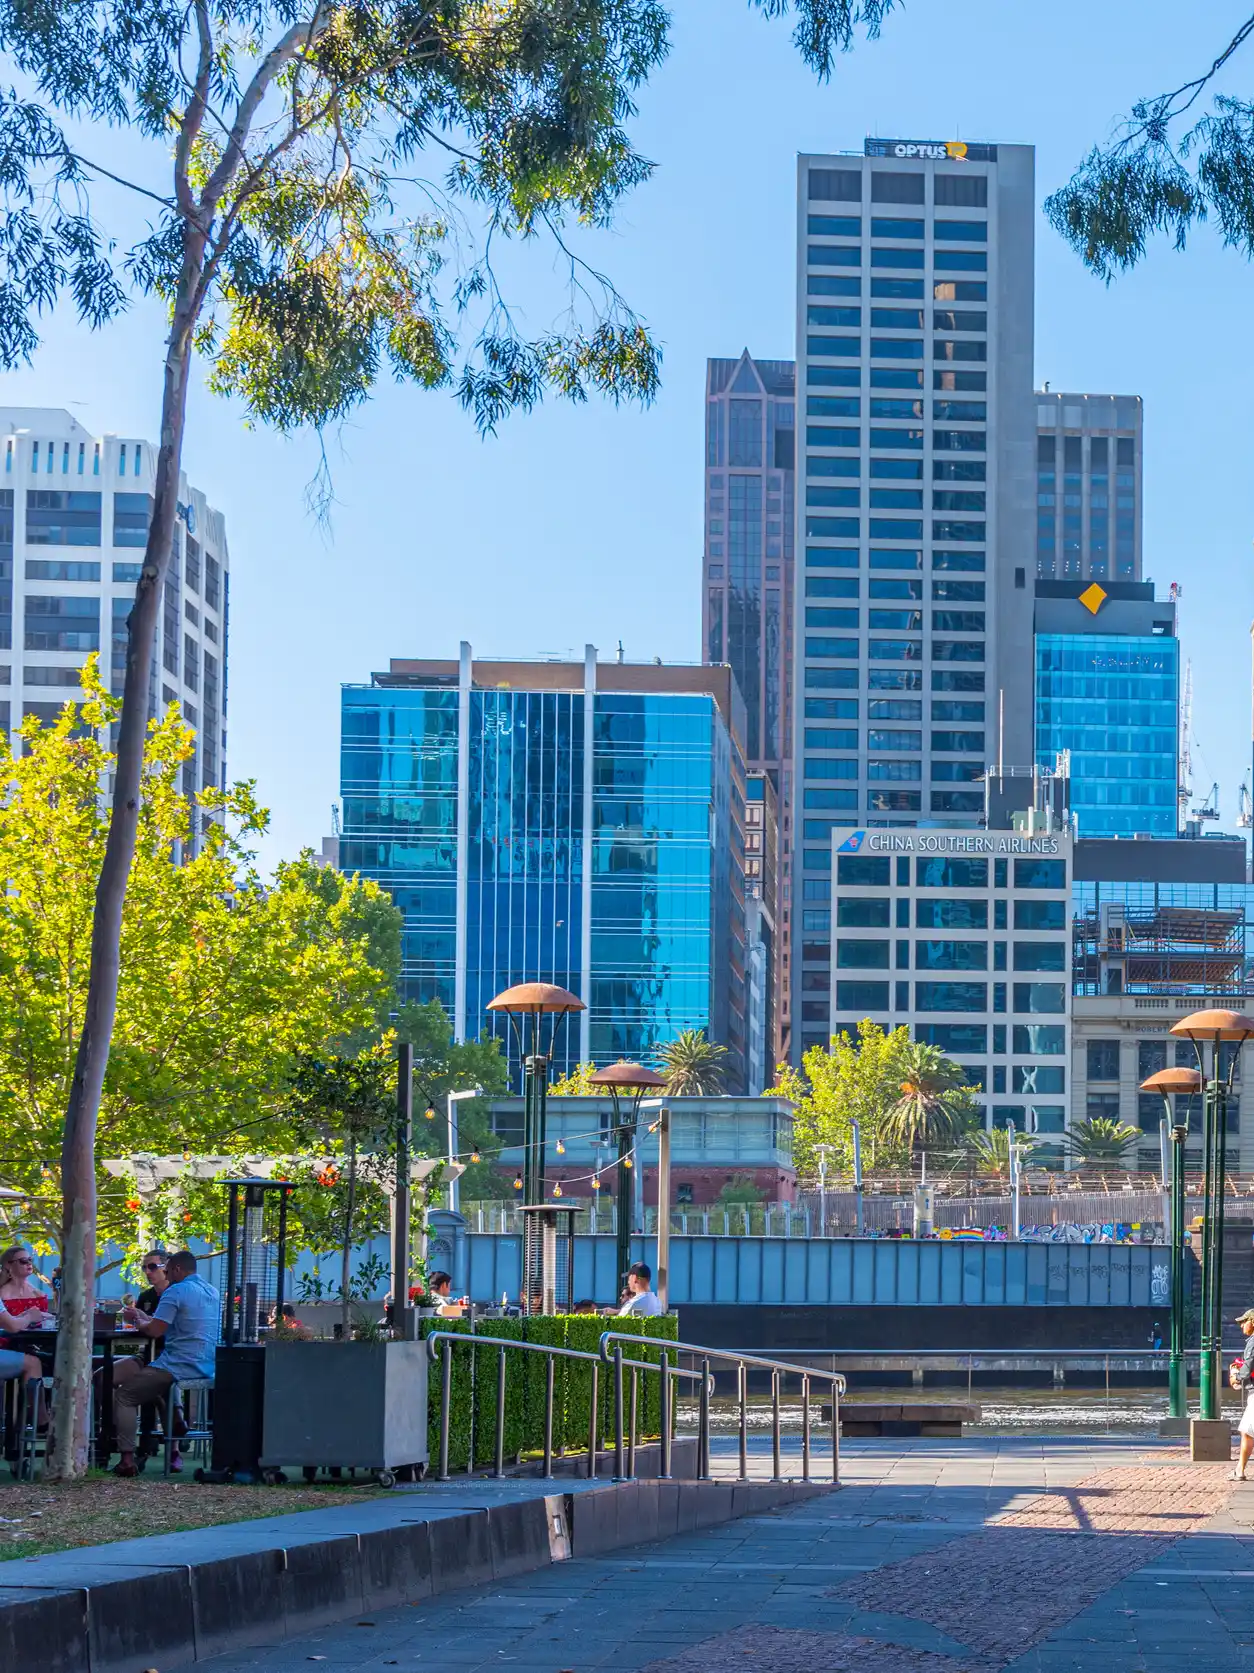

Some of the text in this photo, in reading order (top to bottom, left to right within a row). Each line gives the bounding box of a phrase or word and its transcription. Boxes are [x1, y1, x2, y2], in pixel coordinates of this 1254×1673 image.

[894, 144, 947, 159] OPTUS
[868, 835, 1059, 854] CHINA SOUTHERN AIRLINES
